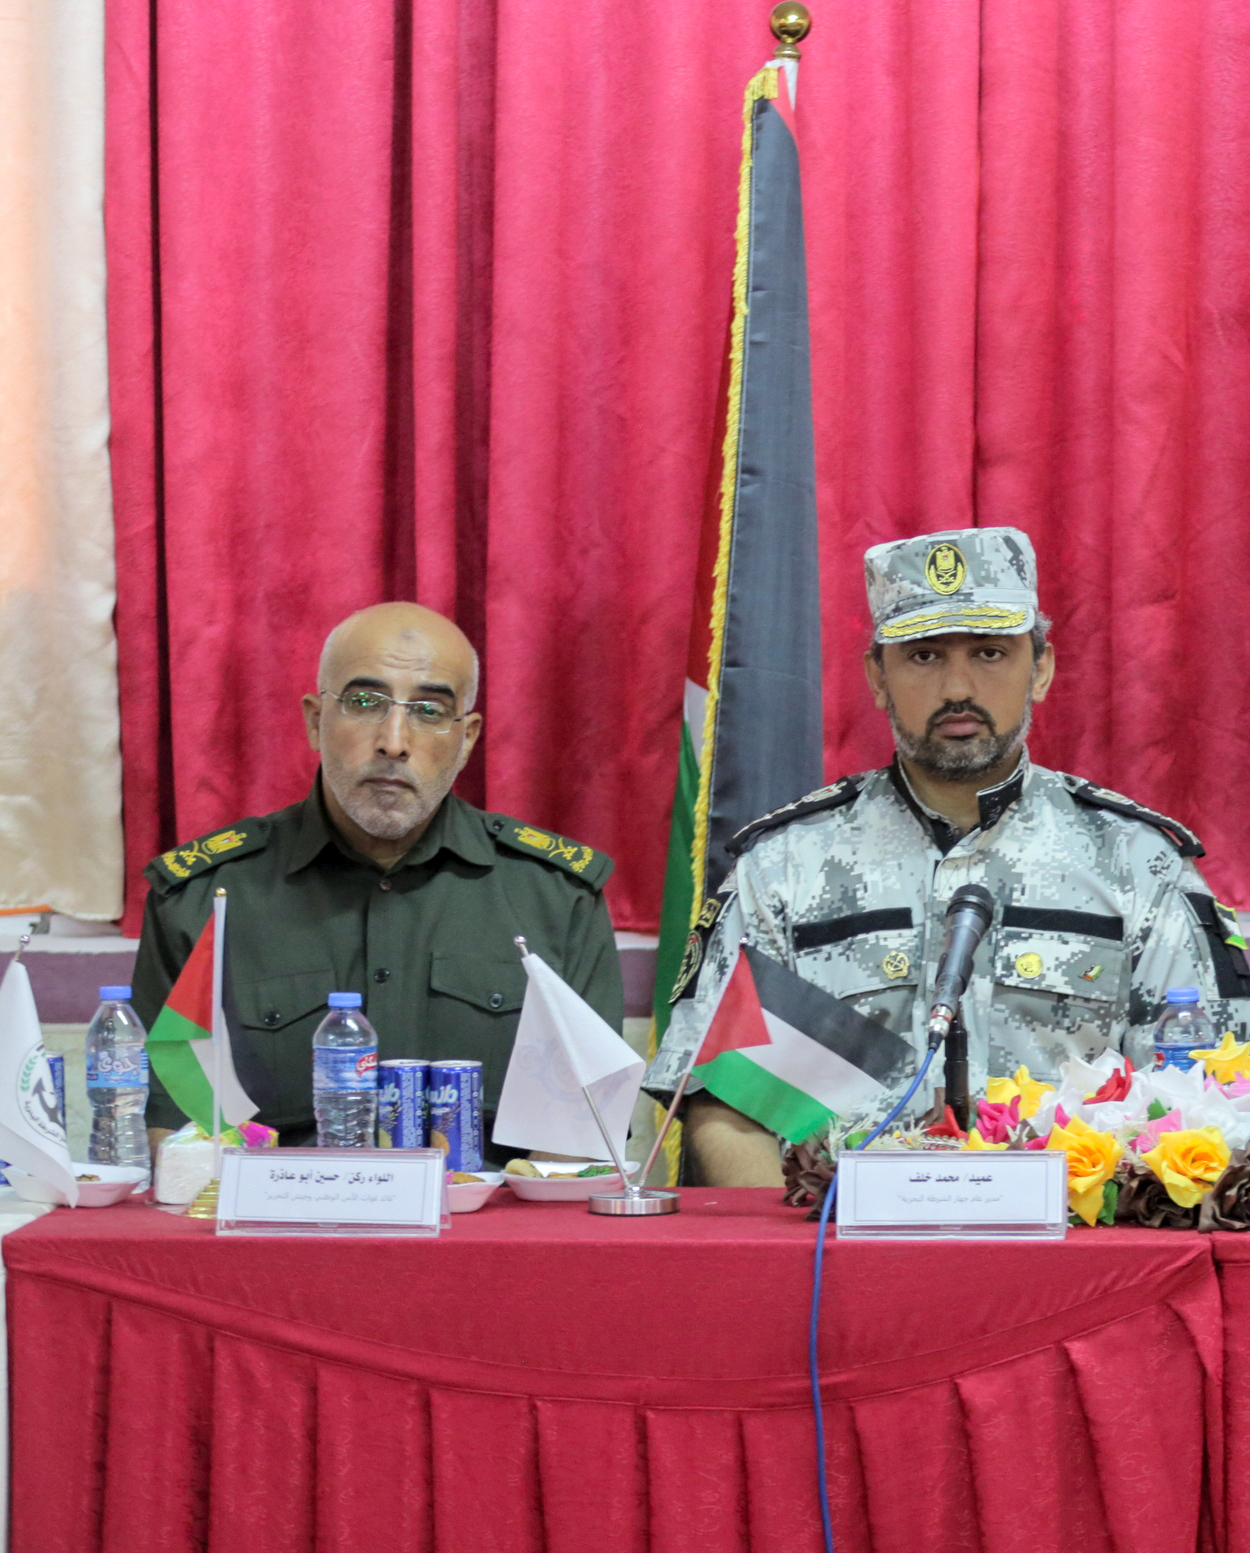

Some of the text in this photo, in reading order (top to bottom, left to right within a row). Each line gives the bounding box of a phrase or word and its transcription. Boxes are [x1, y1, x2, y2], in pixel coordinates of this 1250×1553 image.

[298, 1169, 313, 1184] أبو
[314, 1171, 340, 1185] حسين
[368, 1172, 394, 1185] اللواء
[909, 1172, 932, 1183] خلف
[935, 1173, 959, 1183] محمد
